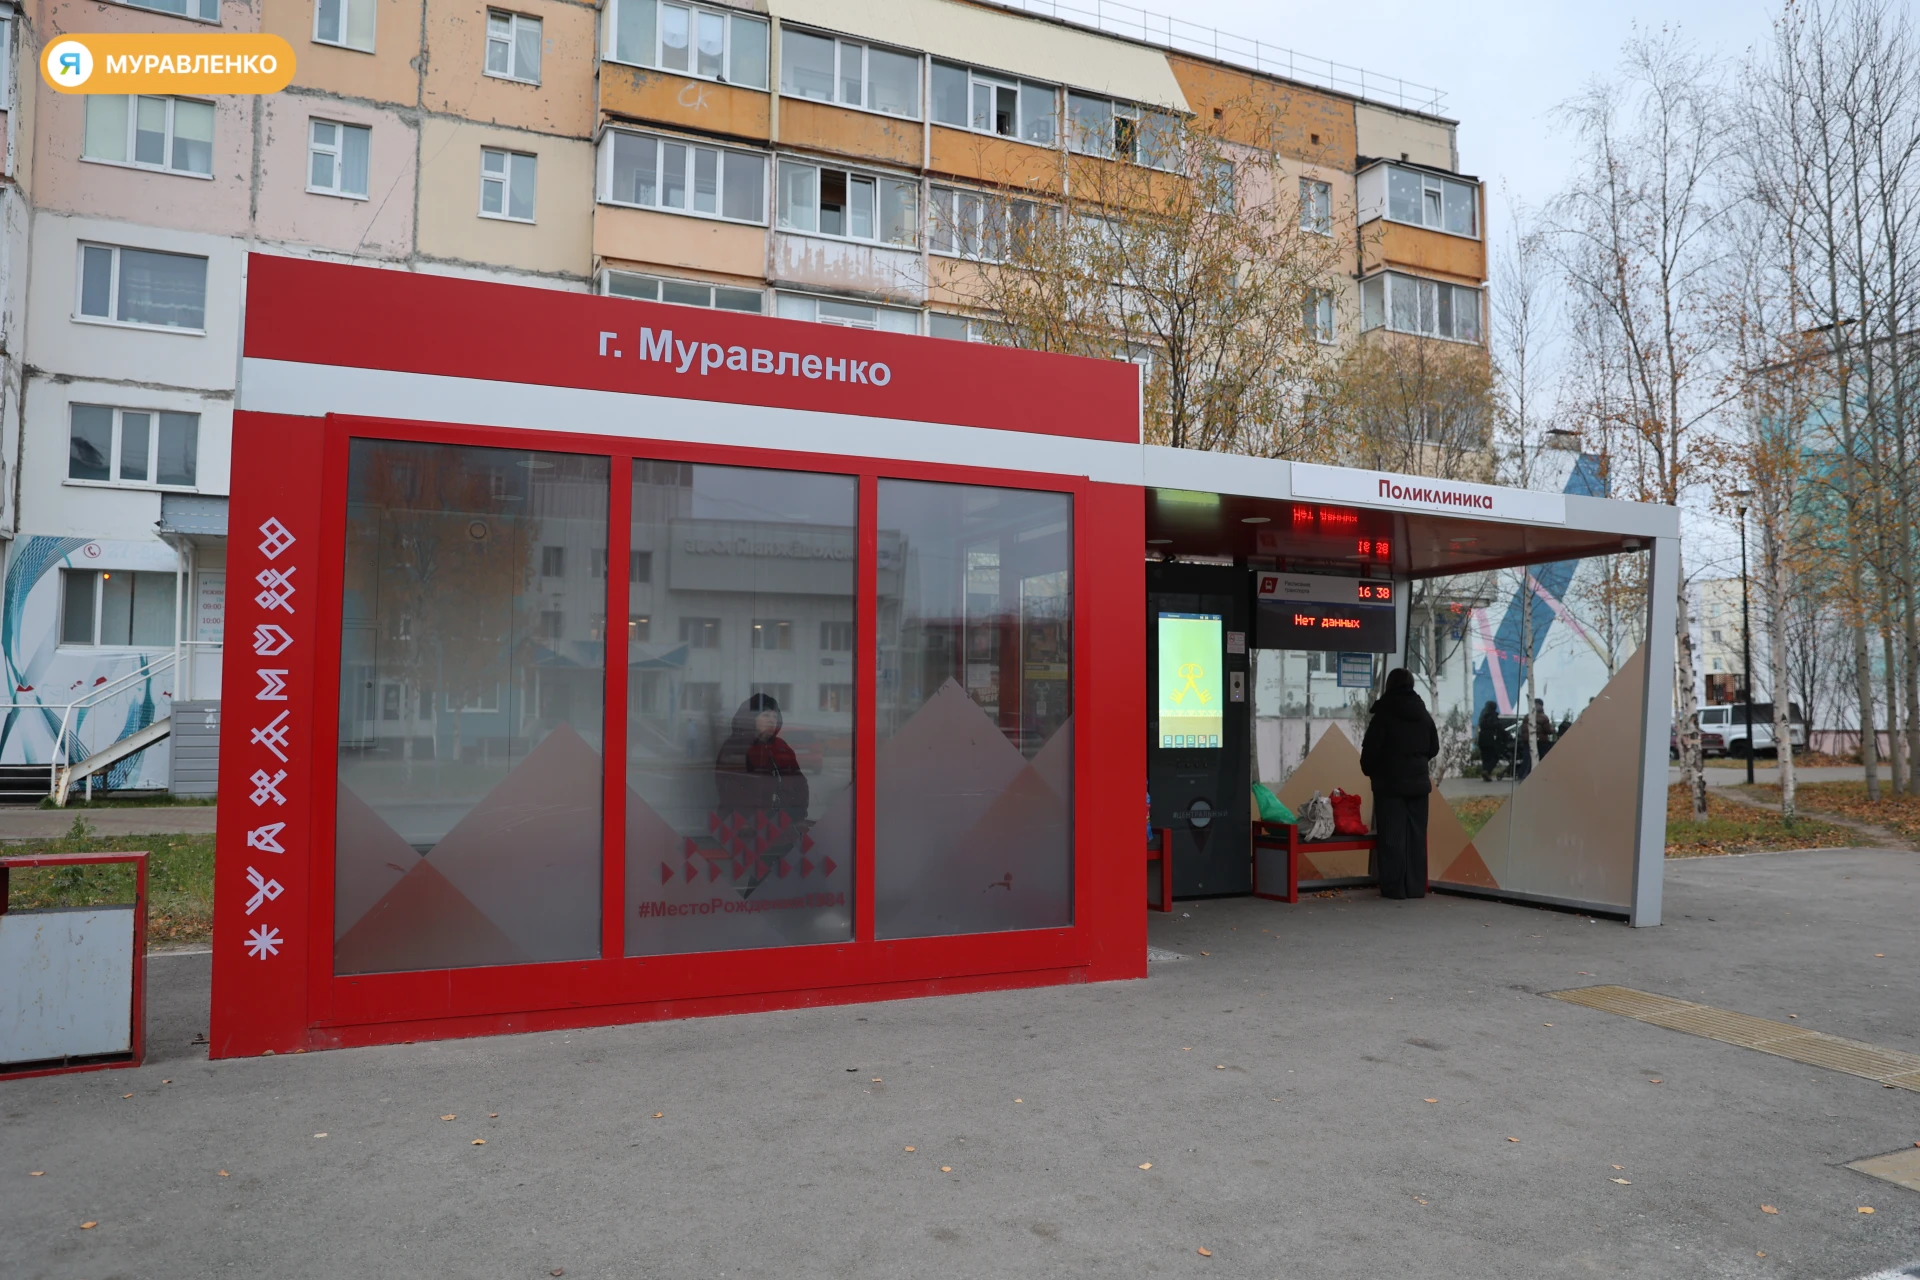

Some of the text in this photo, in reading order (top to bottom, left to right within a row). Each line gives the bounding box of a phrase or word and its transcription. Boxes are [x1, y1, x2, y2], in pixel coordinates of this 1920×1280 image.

[599, 326, 892, 387] г. Муравленко
[1379, 479, 1493, 510] Поликлиника
[1284, 587, 1310, 595] транспорта
[1358, 586, 1390, 599] 16 38
[1294, 613, 1360, 629] Нет данных
[1173, 809, 1228, 820] #ЦЕНТРАЛЬНЫЙ
[638, 891, 846, 919] #МестоРождения1984
